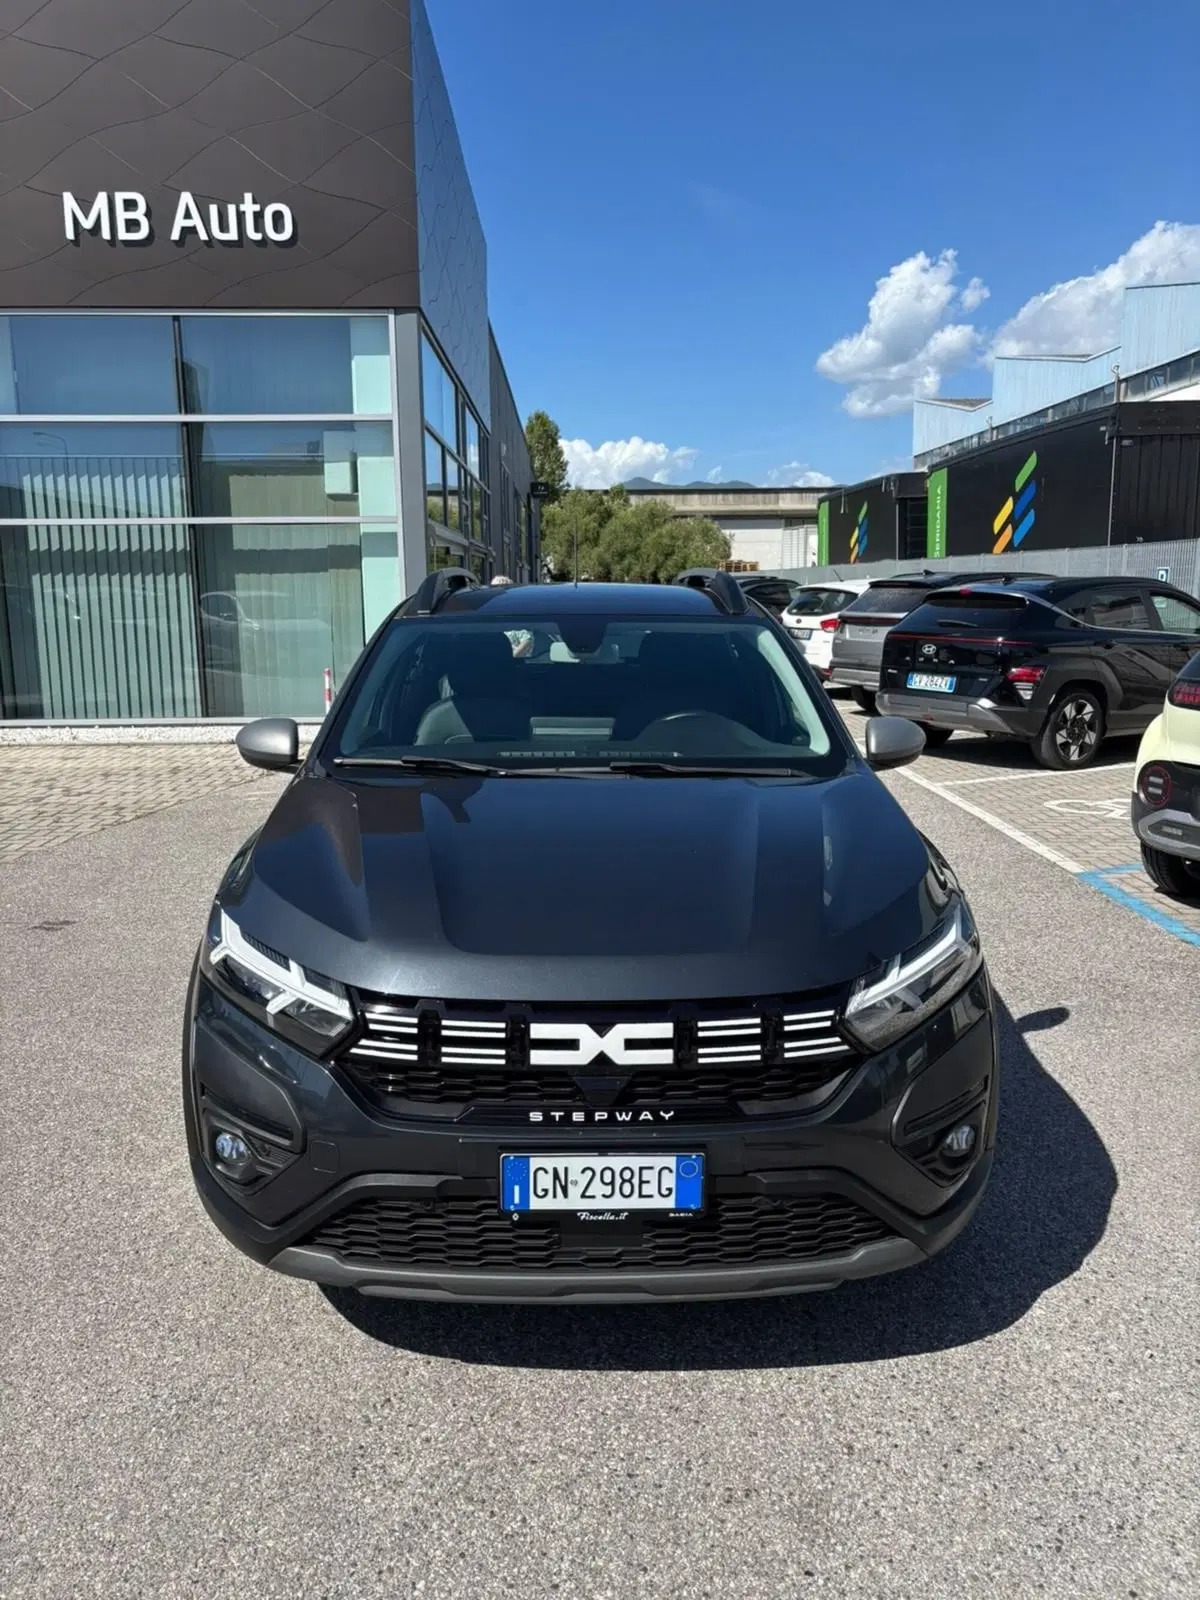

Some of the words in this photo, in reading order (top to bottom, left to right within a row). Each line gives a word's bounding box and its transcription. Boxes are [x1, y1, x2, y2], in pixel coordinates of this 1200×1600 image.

[62, 191, 150, 242] MB
[171, 191, 294, 243] Auto
[529, 1110, 674, 1122] STEPWAY
[532, 1166, 569, 1200] GN
[580, 1166, 674, 1199] 298EG
